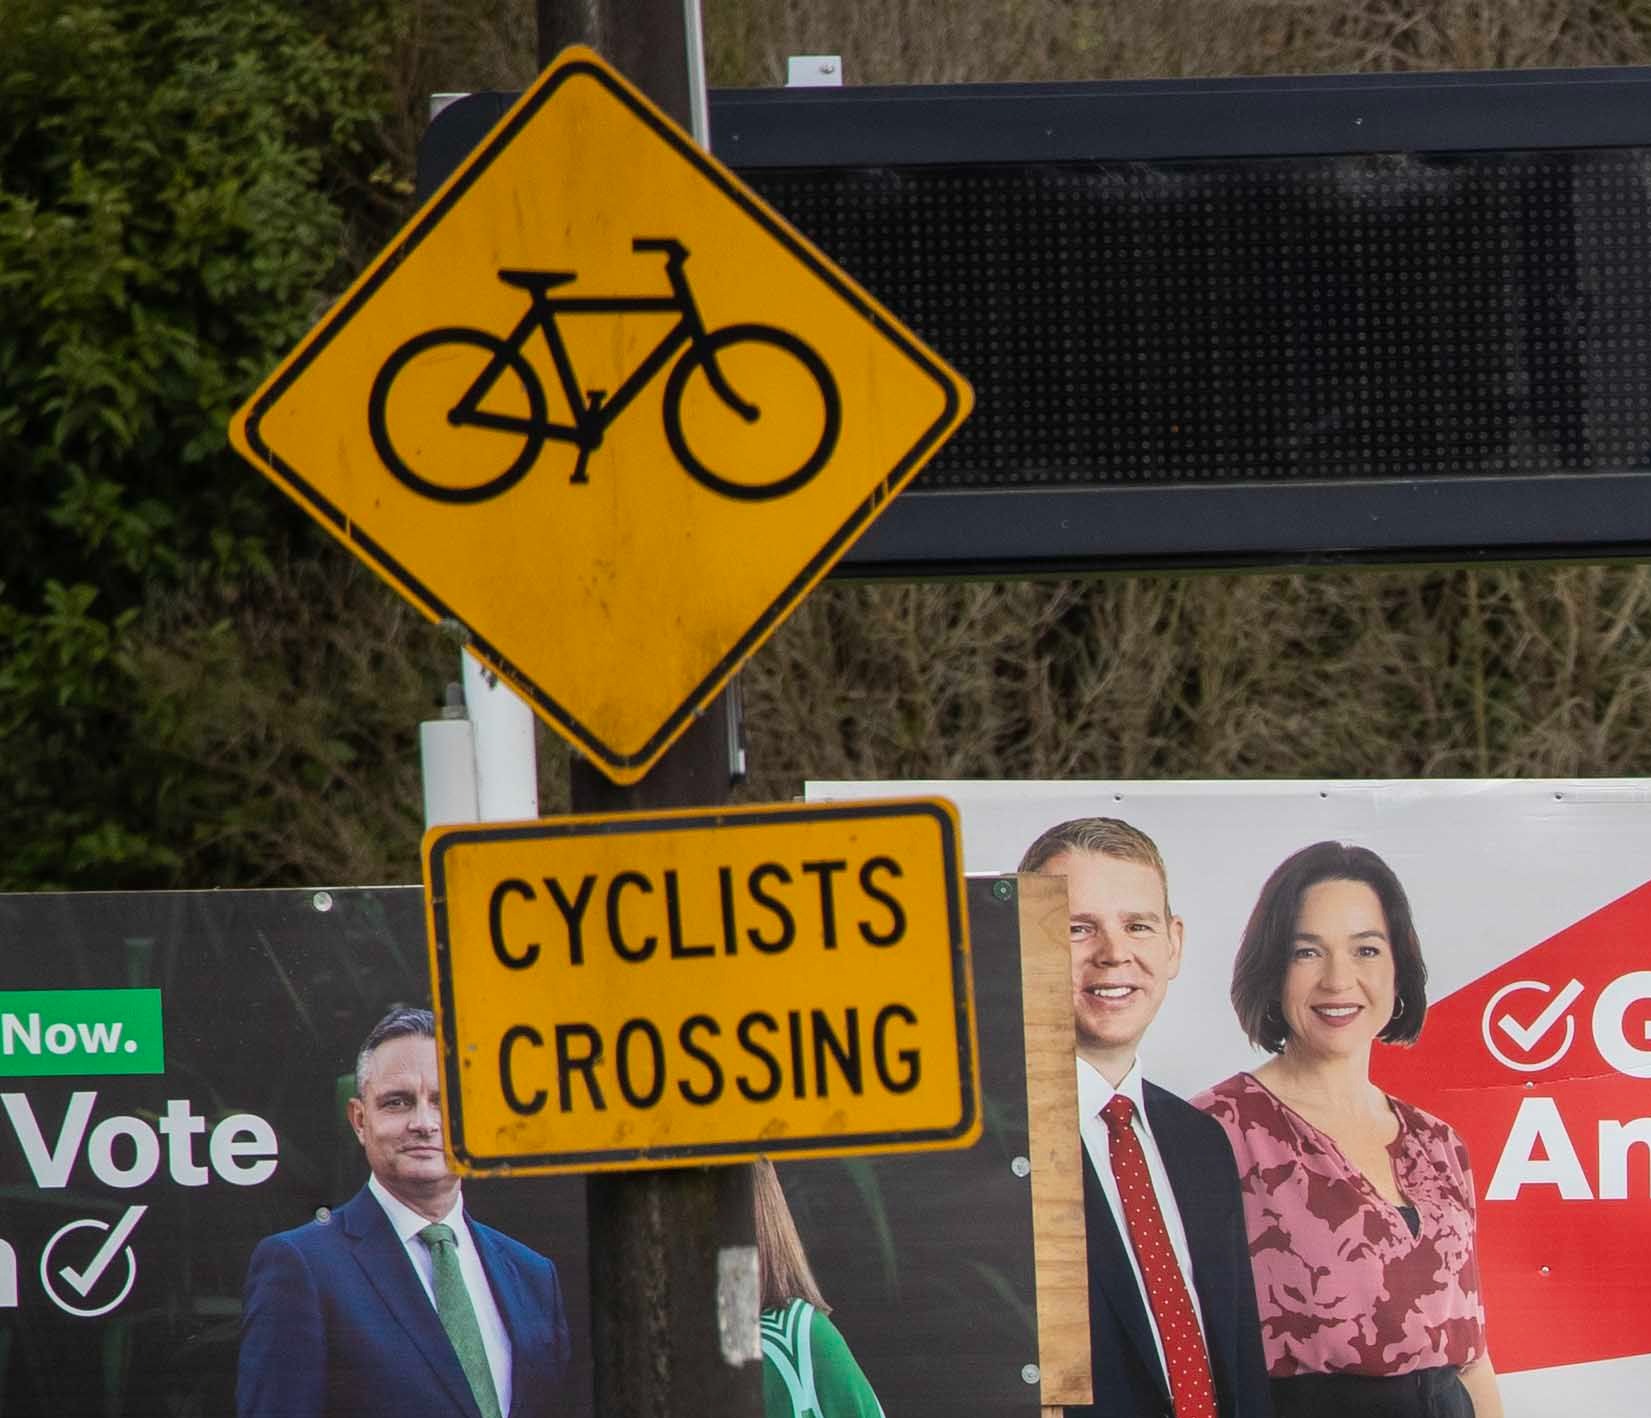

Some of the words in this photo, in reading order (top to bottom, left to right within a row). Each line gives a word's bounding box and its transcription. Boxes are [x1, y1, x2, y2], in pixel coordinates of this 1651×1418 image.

[489, 856, 906, 970] CYCLISTS
[2, 1013, 137, 1054] Now.
[499, 1004, 920, 1116] CROSSING
[0, 1091, 278, 1188] Vote
